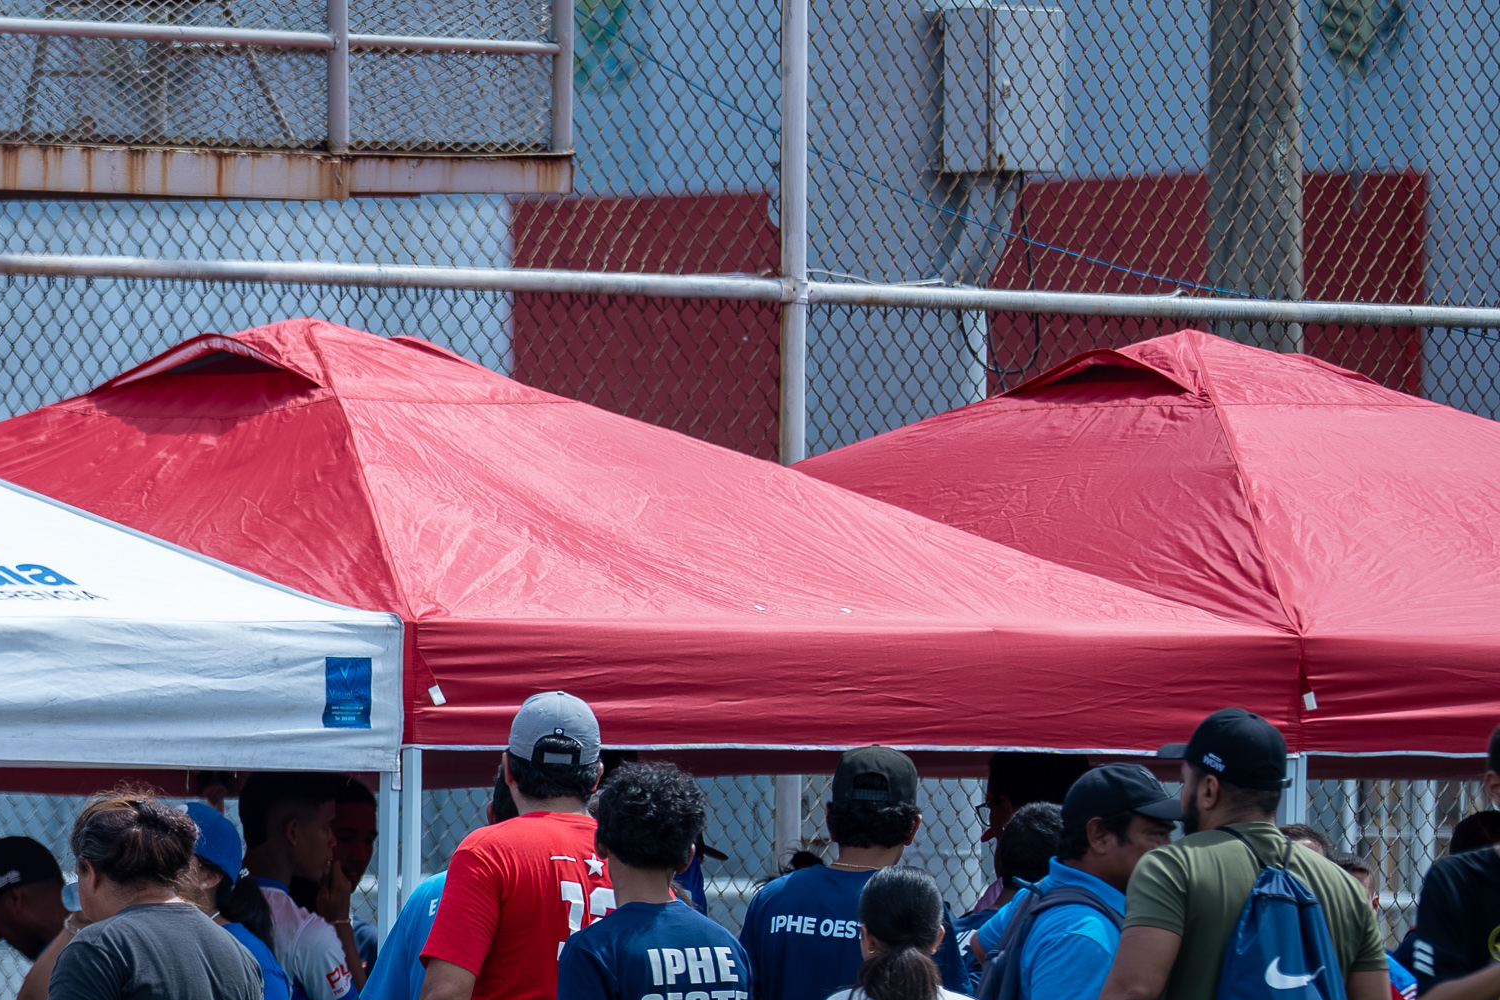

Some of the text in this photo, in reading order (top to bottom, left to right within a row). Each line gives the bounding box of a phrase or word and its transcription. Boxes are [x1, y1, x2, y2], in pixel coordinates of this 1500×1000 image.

[328, 689, 353, 700] Visual
[770, 914, 817, 935] IPHE
[647, 946, 740, 986] IPHE
